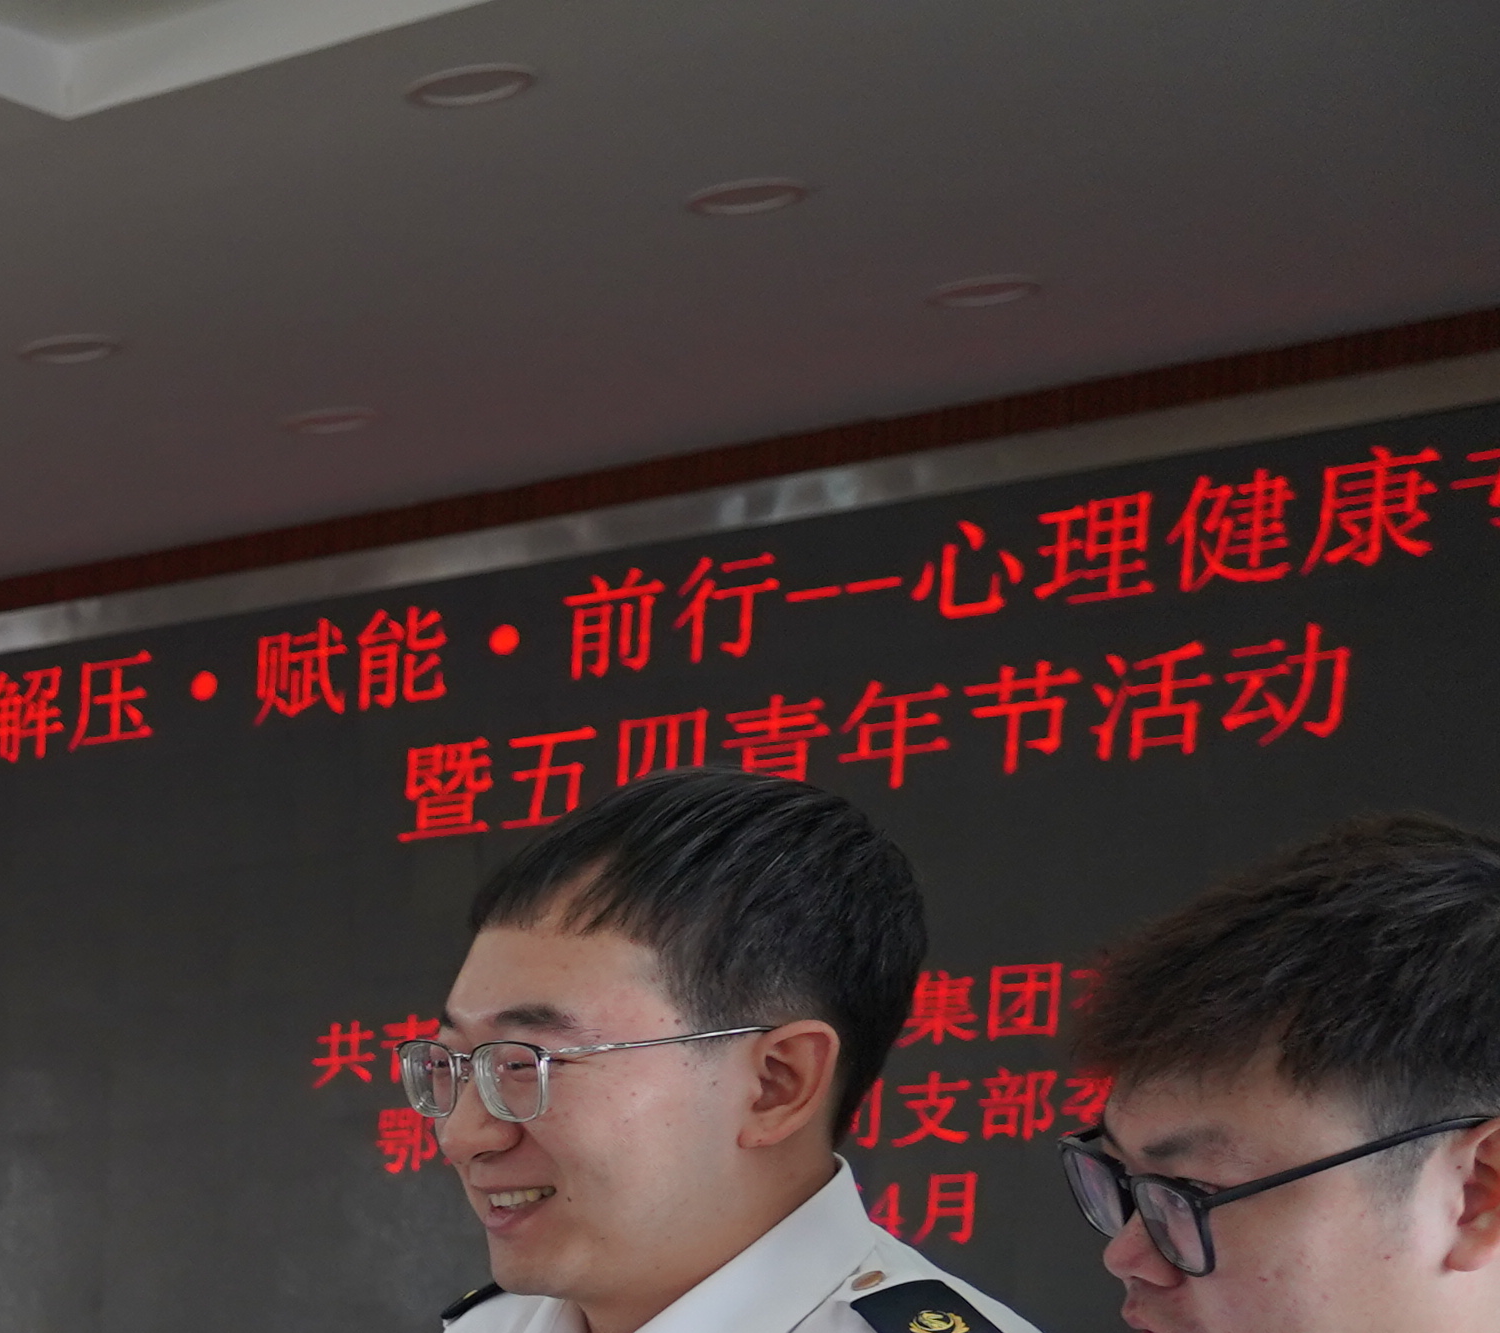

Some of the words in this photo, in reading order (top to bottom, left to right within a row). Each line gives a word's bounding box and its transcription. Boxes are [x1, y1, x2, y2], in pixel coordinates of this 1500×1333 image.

[397, 622, 1353, 843] 暨五四青年节活动
